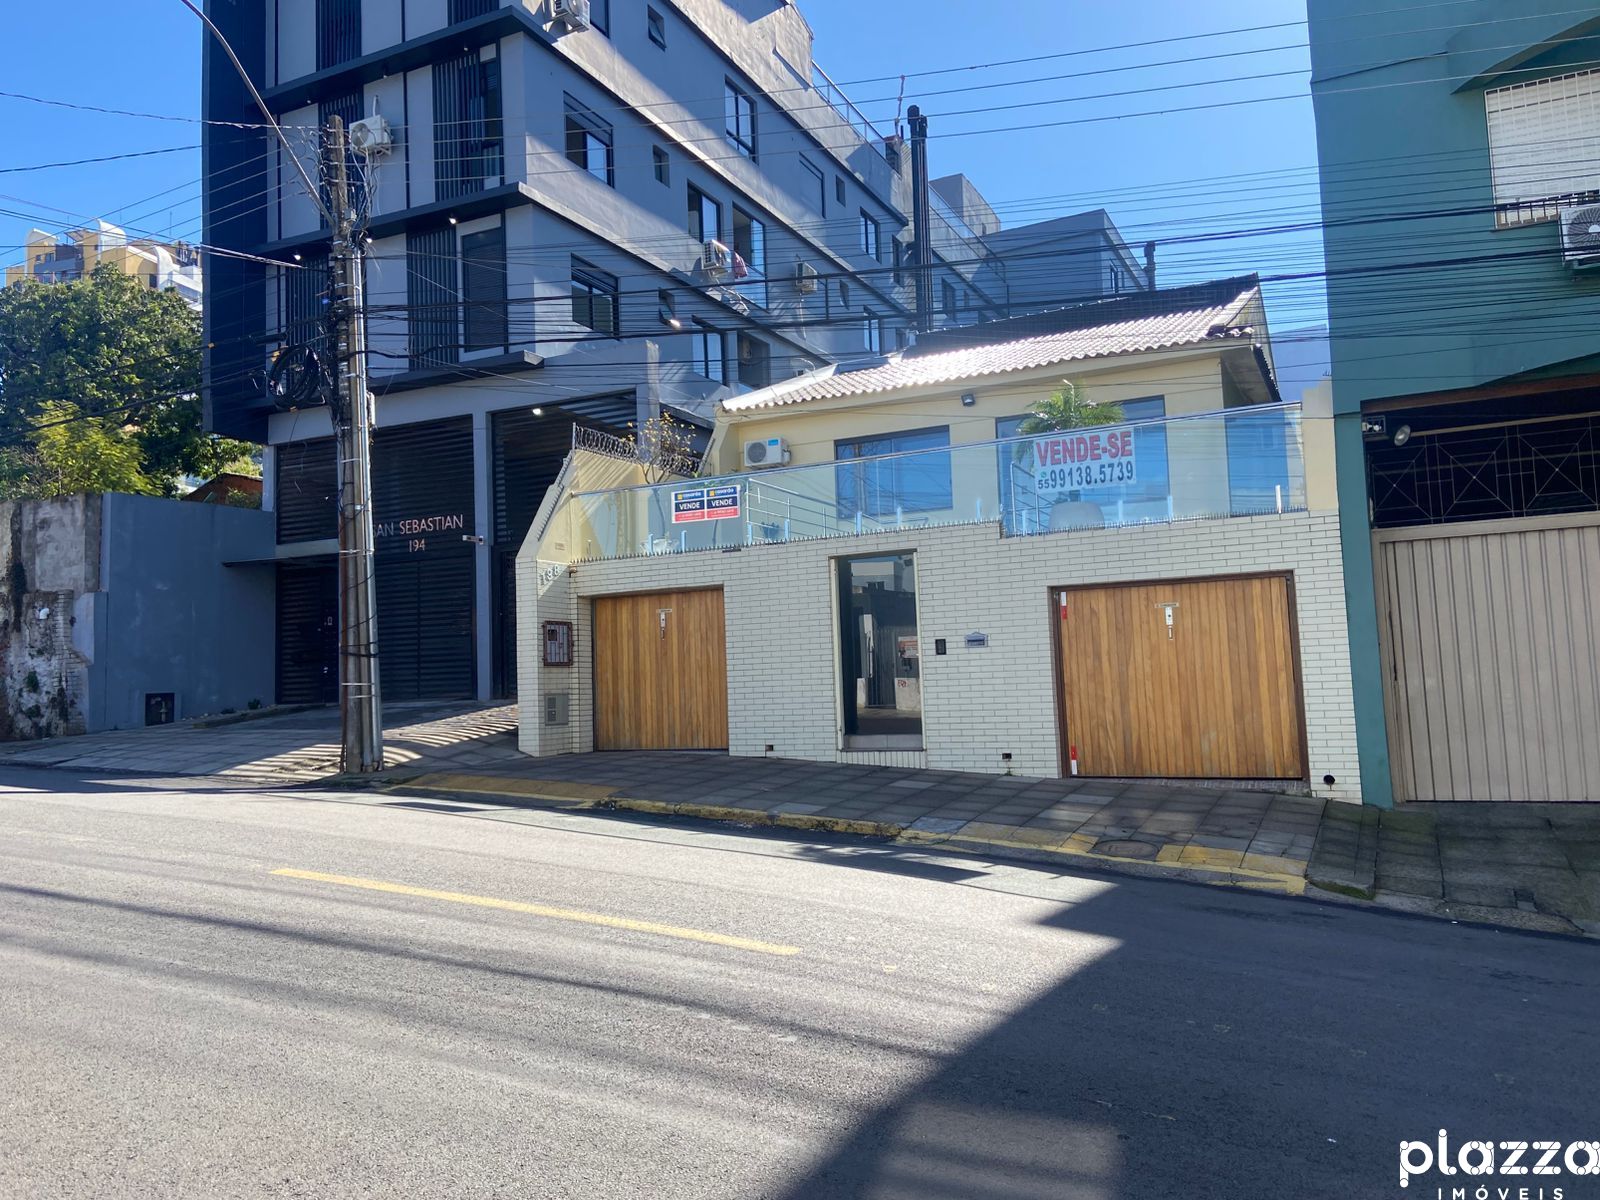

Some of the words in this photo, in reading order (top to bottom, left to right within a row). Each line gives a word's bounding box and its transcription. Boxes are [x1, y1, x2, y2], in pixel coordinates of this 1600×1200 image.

[1036, 431, 1133, 467] VENDE-SE
[679, 502, 700, 510] VENDE
[711, 498, 732, 507] VENDE
[399, 514, 463, 535] SEBASTIAN
[409, 538, 425, 552] 194
